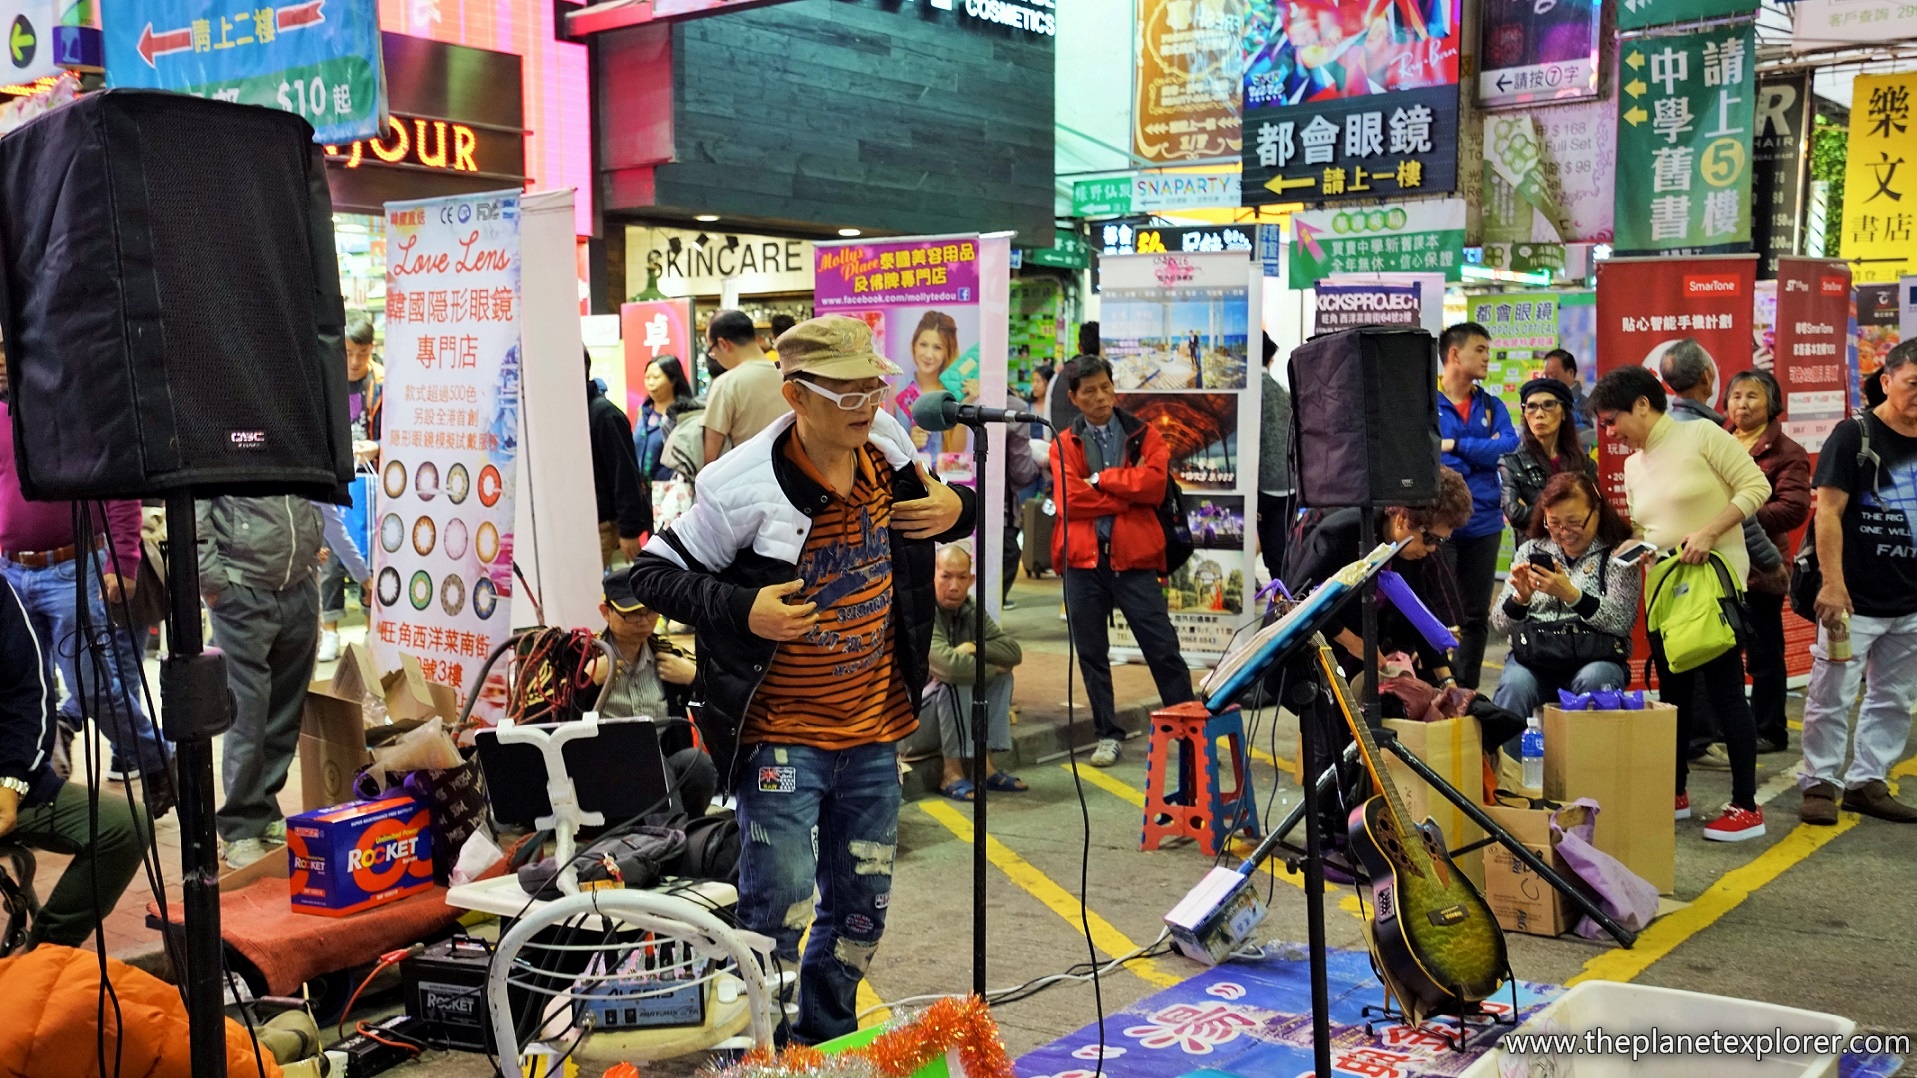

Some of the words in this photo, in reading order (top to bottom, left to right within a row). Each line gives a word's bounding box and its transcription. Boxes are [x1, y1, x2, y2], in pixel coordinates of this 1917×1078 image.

[965, 0, 1056, 36] COSMETICS
[1256, 104, 1433, 167] 都會眼鏡
[1570, 137, 1592, 150] Set
[1864, 85, 1910, 205] 樂文
[1137, 176, 1231, 196] SNAPARTY
[1322, 160, 1422, 195] 請上一樓
[1850, 213, 1913, 245] 書店
[394, 234, 450, 276] Love
[455, 230, 511, 273] Lens
[647, 241, 803, 280] SKINCARE
[879, 242, 976, 271] 泰國美容用品
[854, 267, 947, 293] 及佛牌專門店
[1689, 280, 1735, 292] SmarTone
[821, 292, 957, 306] www.facebook.com/mollytedou
[1476, 301, 1553, 323] 都會眼鏡
[1622, 314, 1733, 332] 貼心智能手機計劃
[416, 334, 479, 369] 專門店
[1859, 526, 1883, 535] ONE
[294, 856, 326, 871] ROCKET
[347, 837, 419, 874] ROCKET
